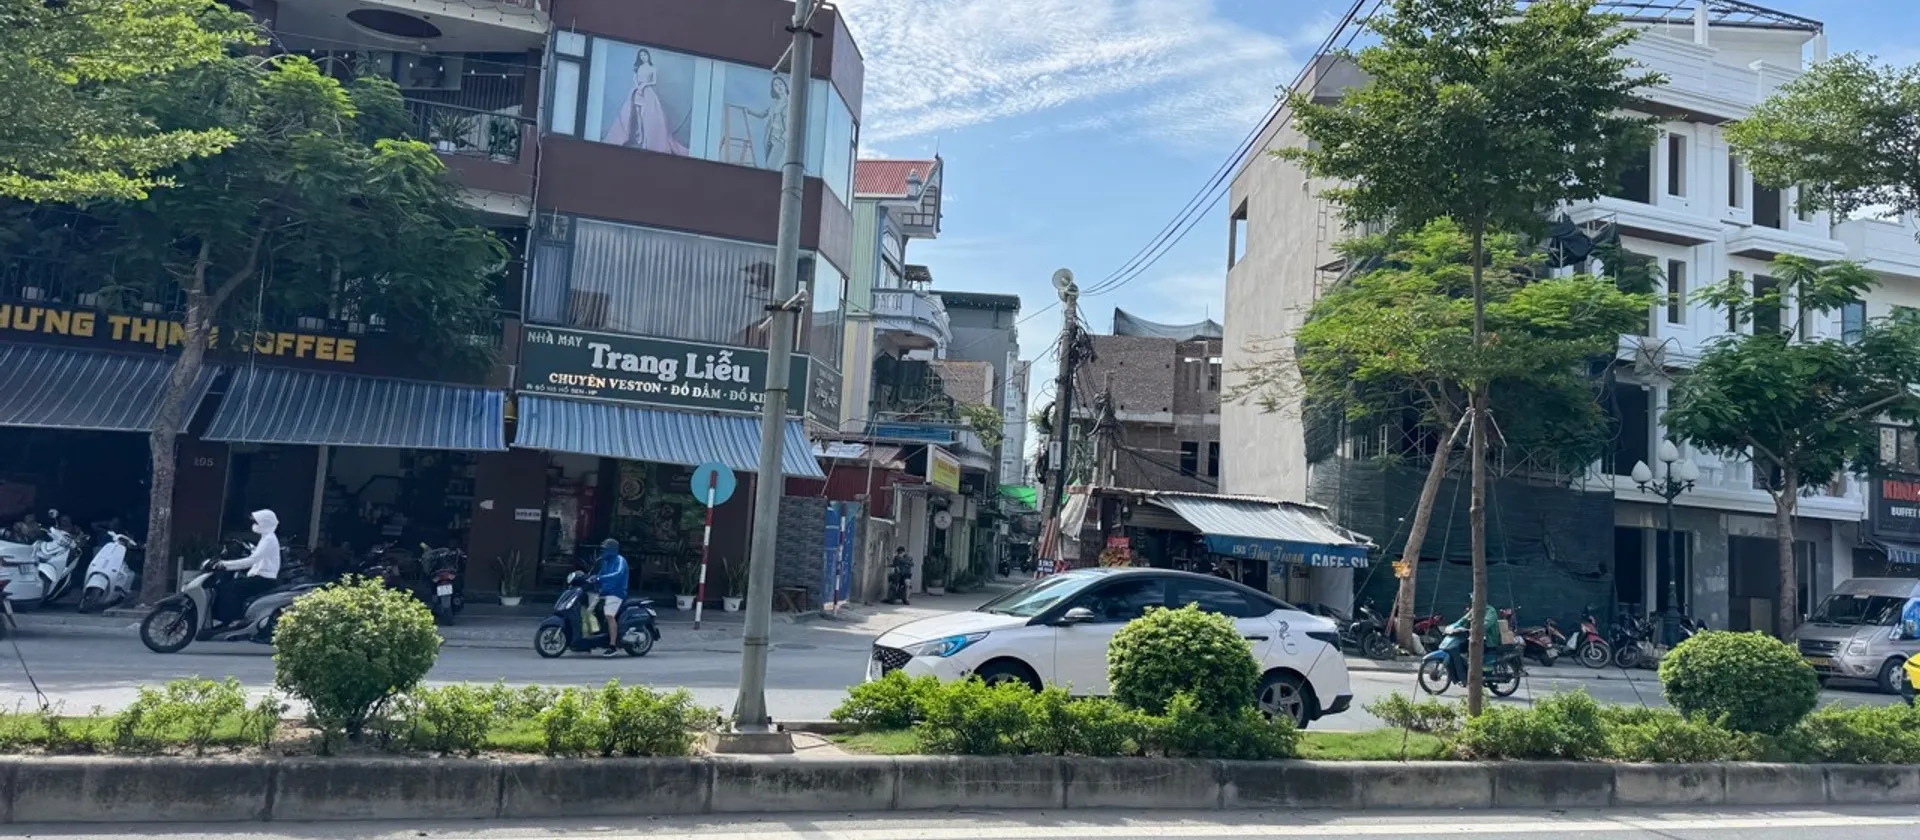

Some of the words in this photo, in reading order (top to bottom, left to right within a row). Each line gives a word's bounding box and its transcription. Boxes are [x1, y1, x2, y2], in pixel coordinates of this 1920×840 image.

[231, 329, 357, 362] OFFEE
[527, 331, 554, 345] NHÀ
[557, 334, 584, 348] MAY
[588, 342, 679, 382] Trang
[685, 350, 750, 383] Liễu
[549, 372, 606, 388] CHUYÊN
[609, 378, 662, 393] VESTON
